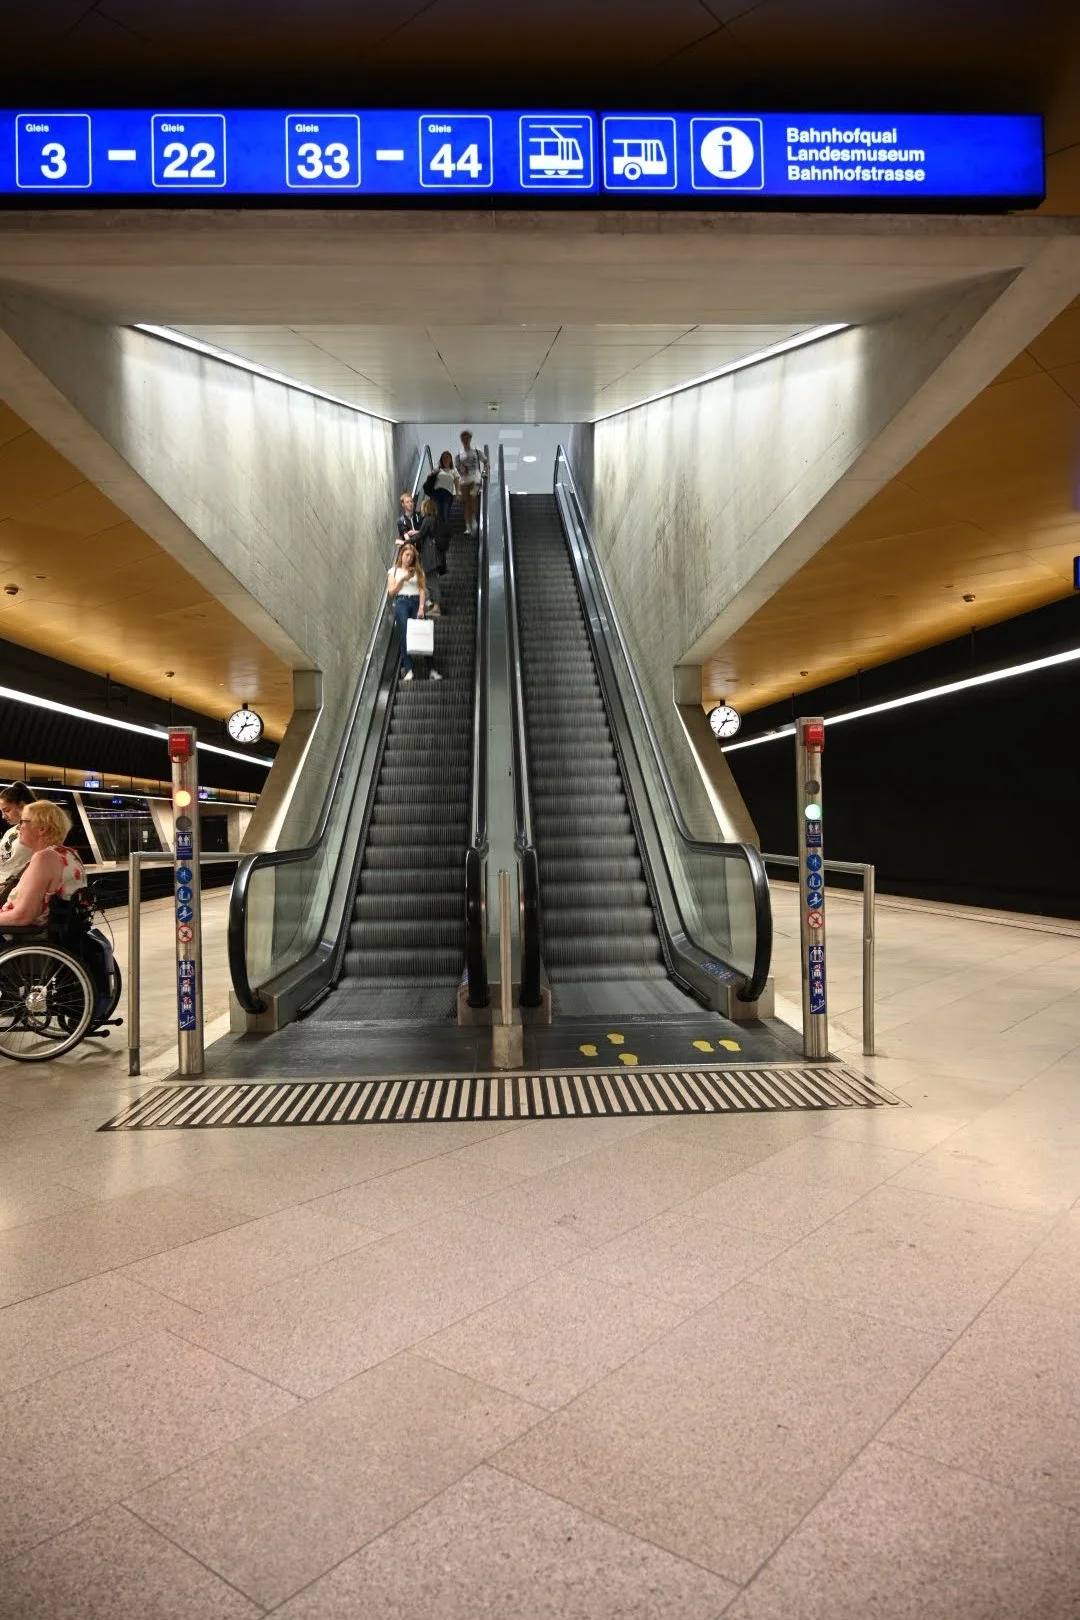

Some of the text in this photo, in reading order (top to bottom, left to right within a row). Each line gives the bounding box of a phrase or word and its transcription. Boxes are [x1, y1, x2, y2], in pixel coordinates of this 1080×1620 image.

[25, 124, 50, 133] Gleis
[160, 124, 185, 133] Gleis
[295, 124, 320, 133] Gleis
[428, 124, 453, 133] Gleis
[786, 127, 898, 147] Bahnhofquai
[40, 143, 68, 180] 3
[163, 143, 216, 178] 22
[296, 143, 351, 180] 33
[429, 144, 483, 178] 44
[786, 147, 925, 162] Landesmuseum
[787, 165, 926, 182] Bahnhofstrasse
